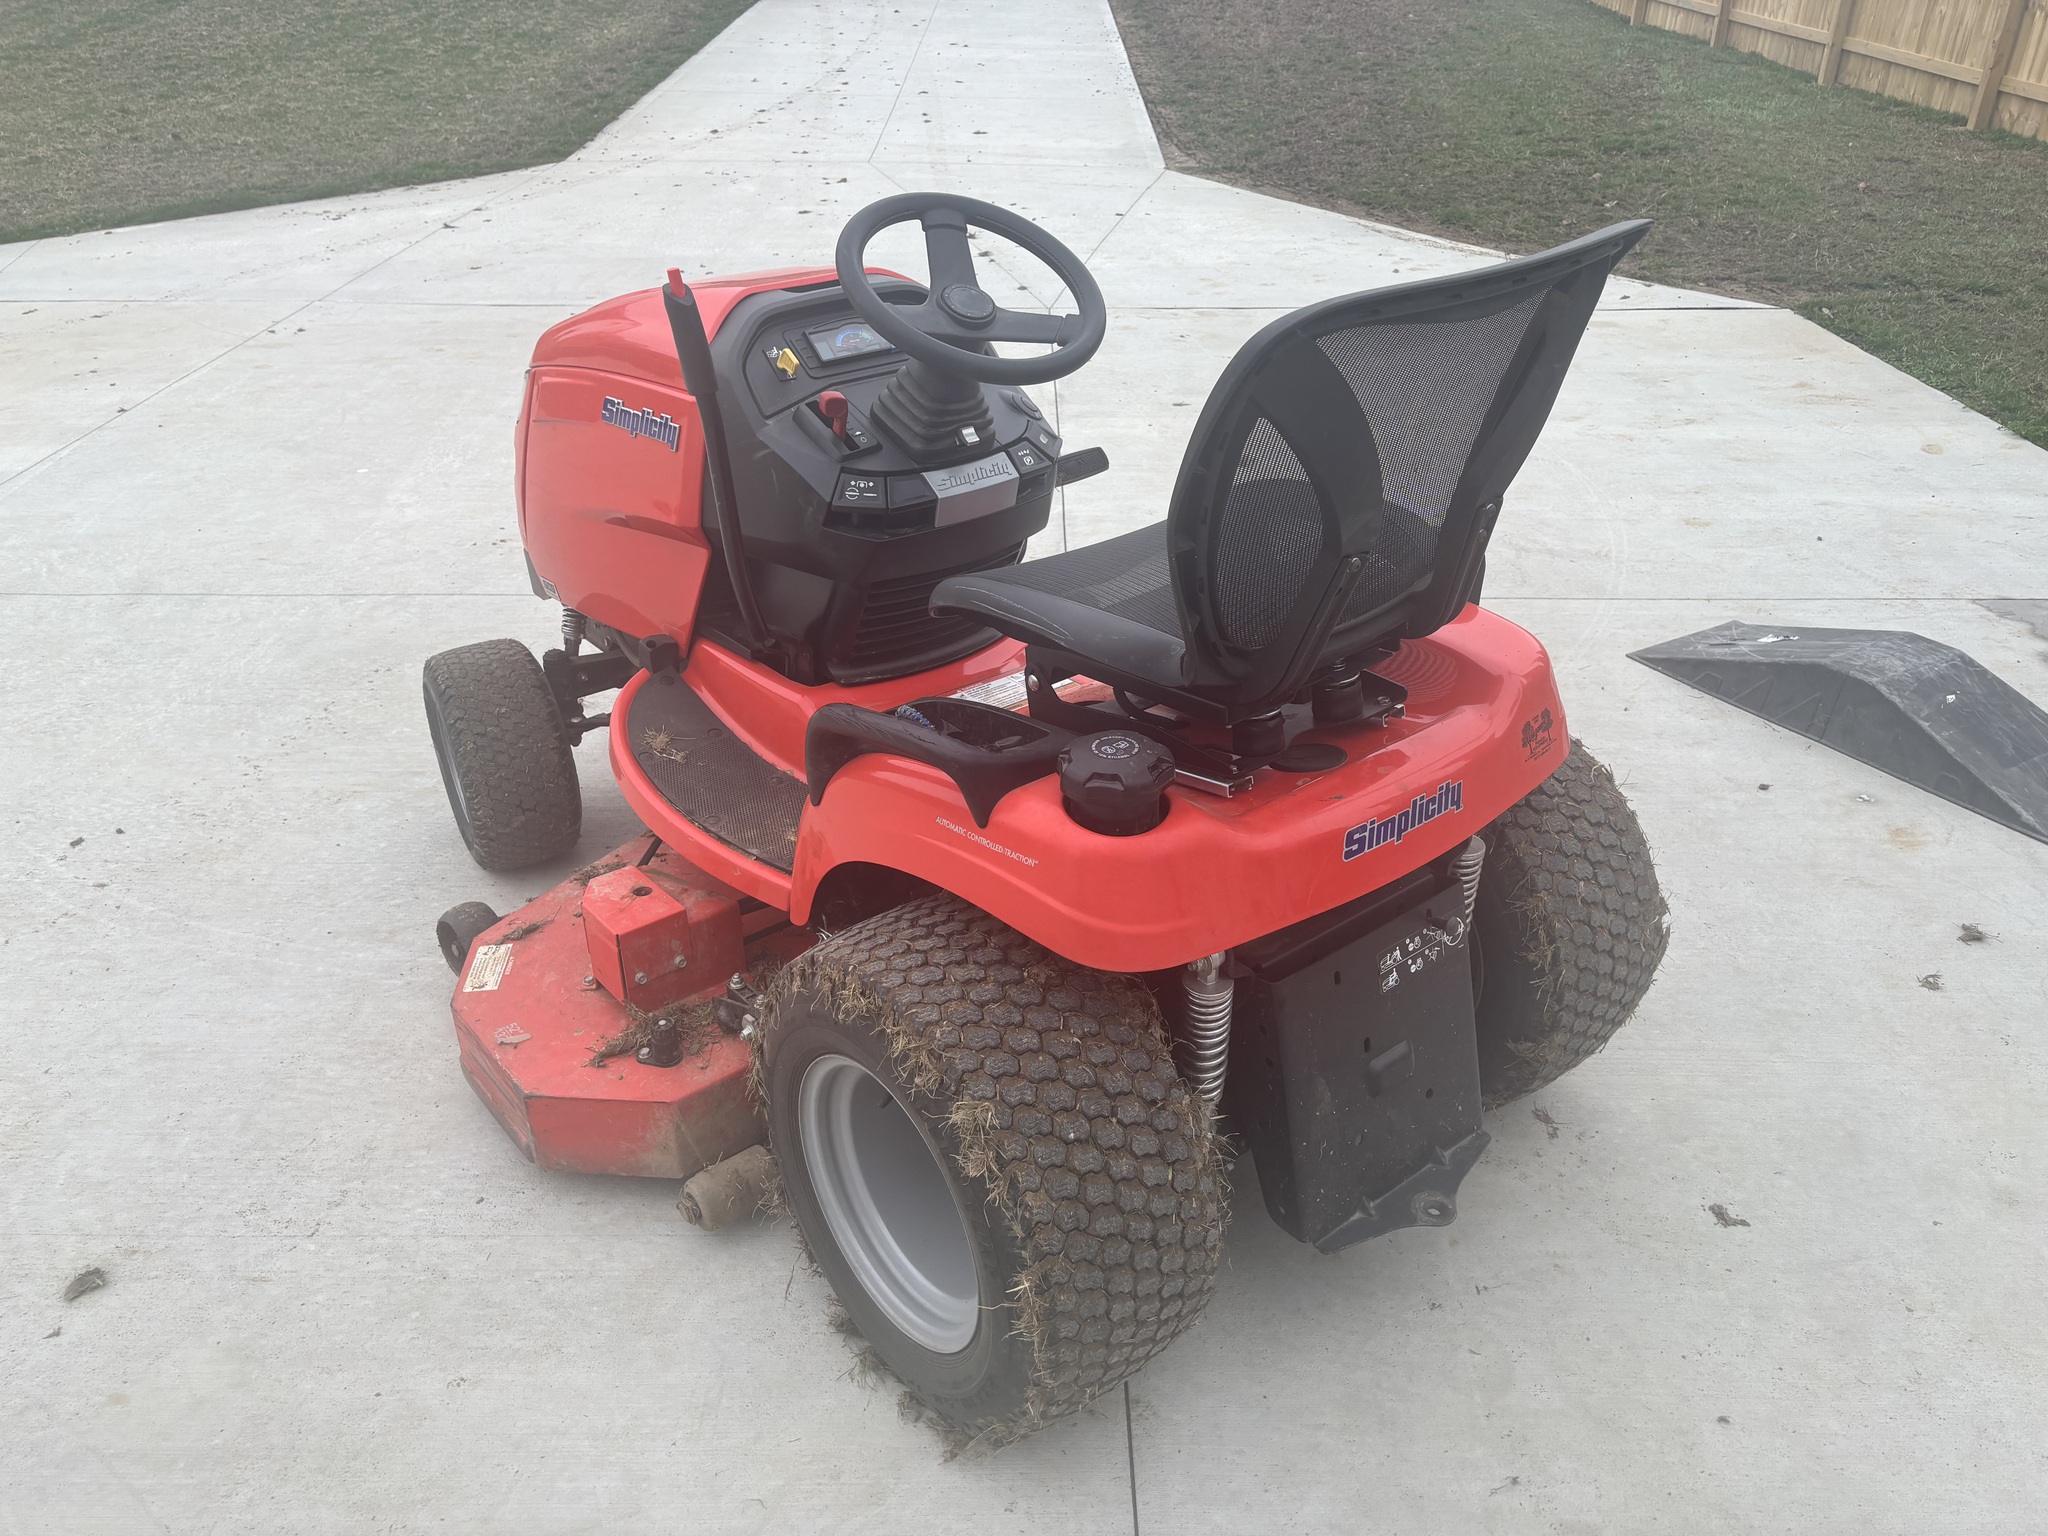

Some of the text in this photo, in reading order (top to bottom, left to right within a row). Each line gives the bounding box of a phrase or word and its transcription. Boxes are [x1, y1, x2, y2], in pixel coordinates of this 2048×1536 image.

[602, 396, 680, 452] Simplicity
[938, 463, 1012, 491] Simplicity
[936, 816, 967, 836] AUTOMATIC
[967, 832, 1003, 854] CONTROLLED
[1343, 780, 1463, 862] Simplicity
